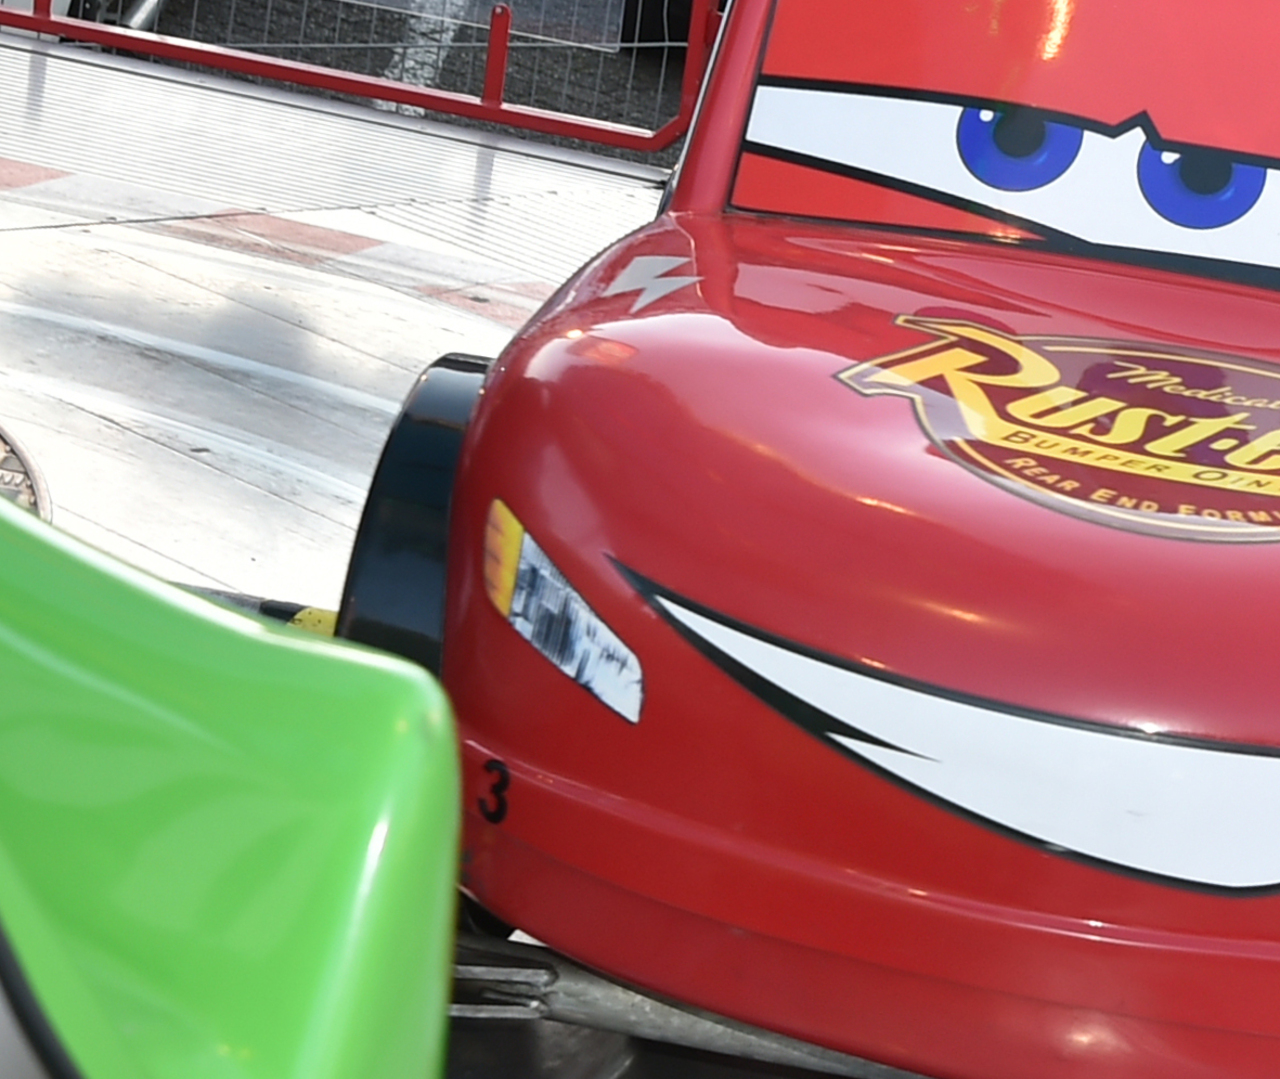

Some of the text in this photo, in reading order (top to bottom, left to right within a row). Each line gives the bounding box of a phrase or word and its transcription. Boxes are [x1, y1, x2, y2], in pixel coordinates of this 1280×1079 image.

[1004, 457, 1080, 492] REAR
[1090, 488, 1160, 514] END
[477, 759, 510, 824] 3
